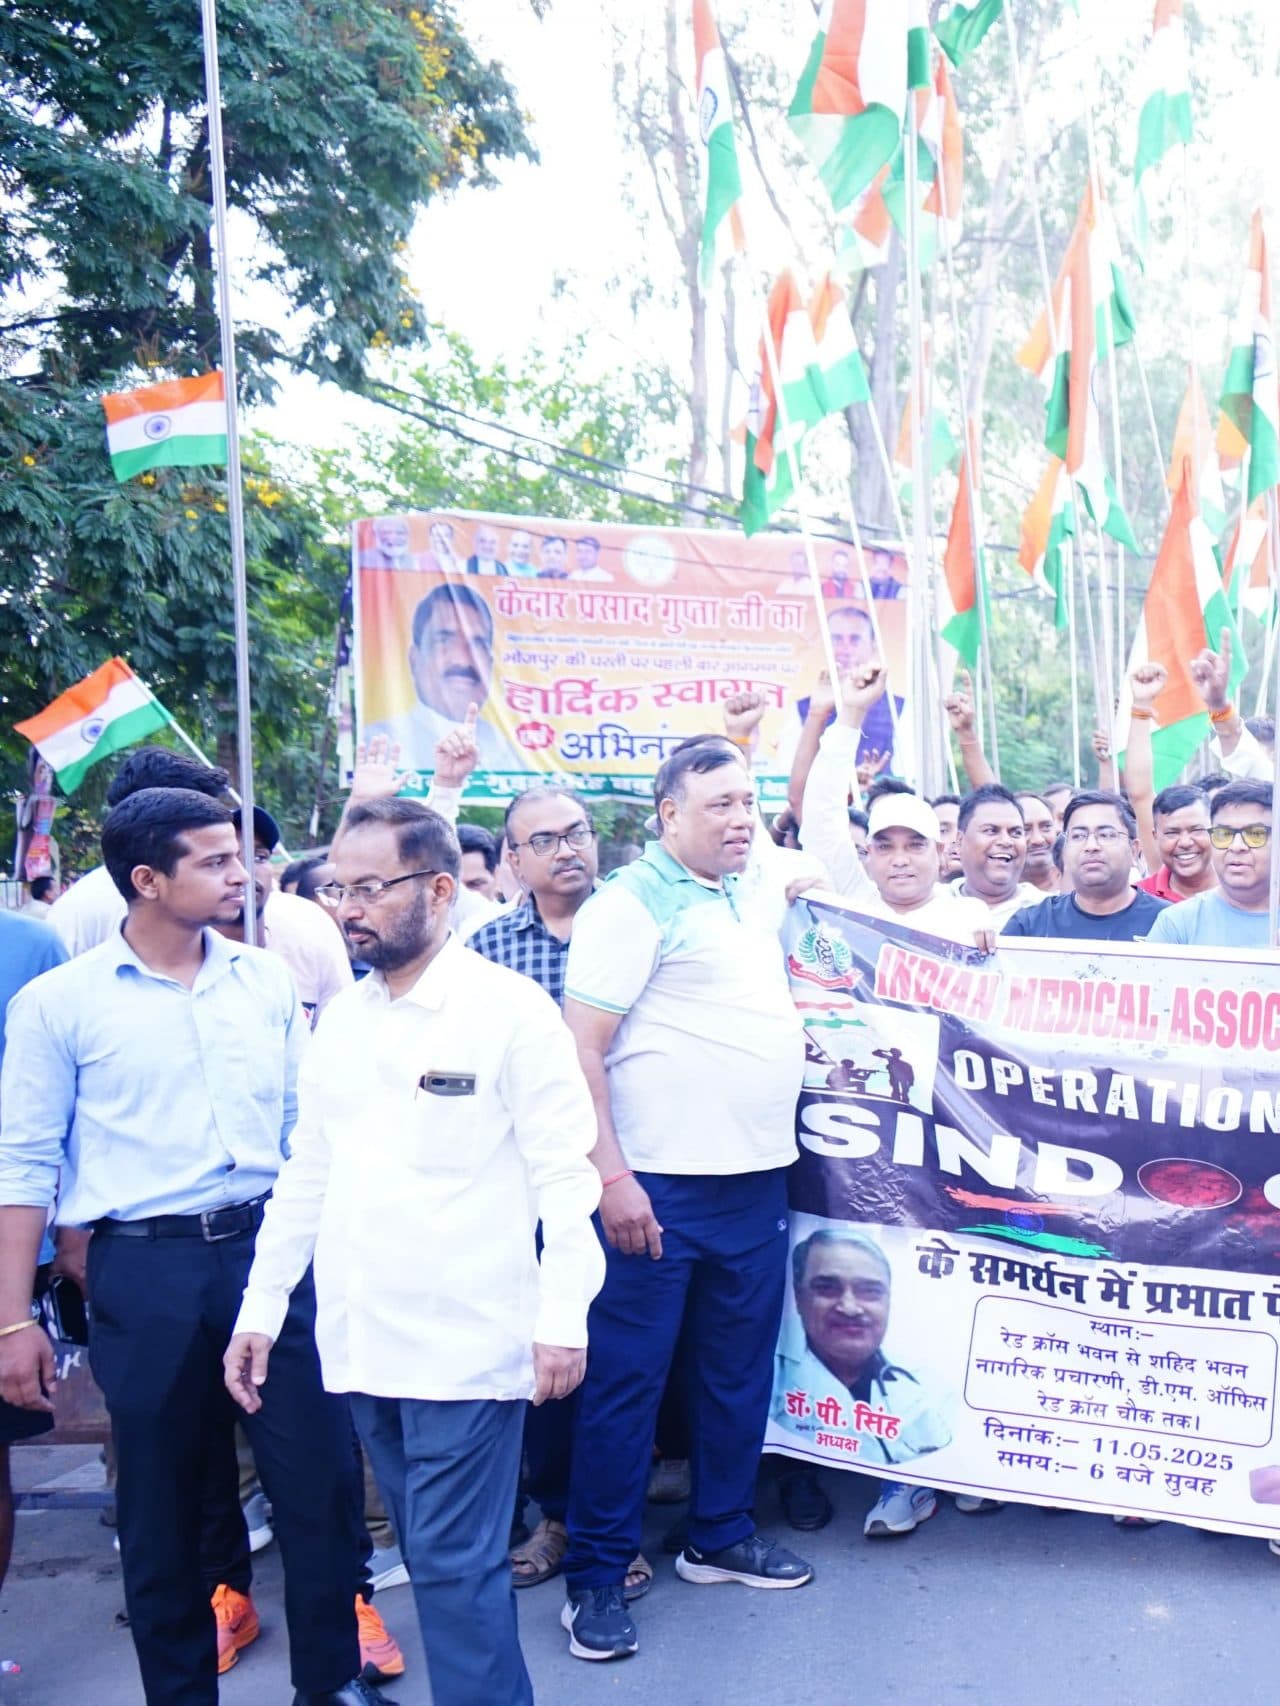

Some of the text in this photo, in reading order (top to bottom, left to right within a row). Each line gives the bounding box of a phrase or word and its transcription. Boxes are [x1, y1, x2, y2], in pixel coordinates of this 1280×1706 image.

[493, 580, 805, 635] केदार प्रसाद गुप्ता जी का
[504, 678, 642, 716] हार्दिक
[876, 945, 1000, 1023] INDIAN
[916, 1238, 961, 1279] के
[967, 1251, 1090, 1304] समर्थन
[1096, 1268, 1138, 1310] में
[1142, 1281, 1256, 1321] प्रभात
[1000, 1326, 1249, 1379] रेड क्रॉस भवन से शहिद भवन
[975, 1357, 1047, 1380] नागरिक
[1207, 1385, 1268, 1411] ऑफिस
[854, 1403, 900, 1440] सिंह
[1037, 1390, 1065, 1413] रेड
[1069, 1394, 1109, 1417] क्रॉस
[1115, 1397, 1156, 1424] चौक
[815, 1432, 860, 1452] अध्यक्ष
[1092, 1436, 1234, 1472] 11.05.2025
[1089, 1462, 1105, 1480] 6
